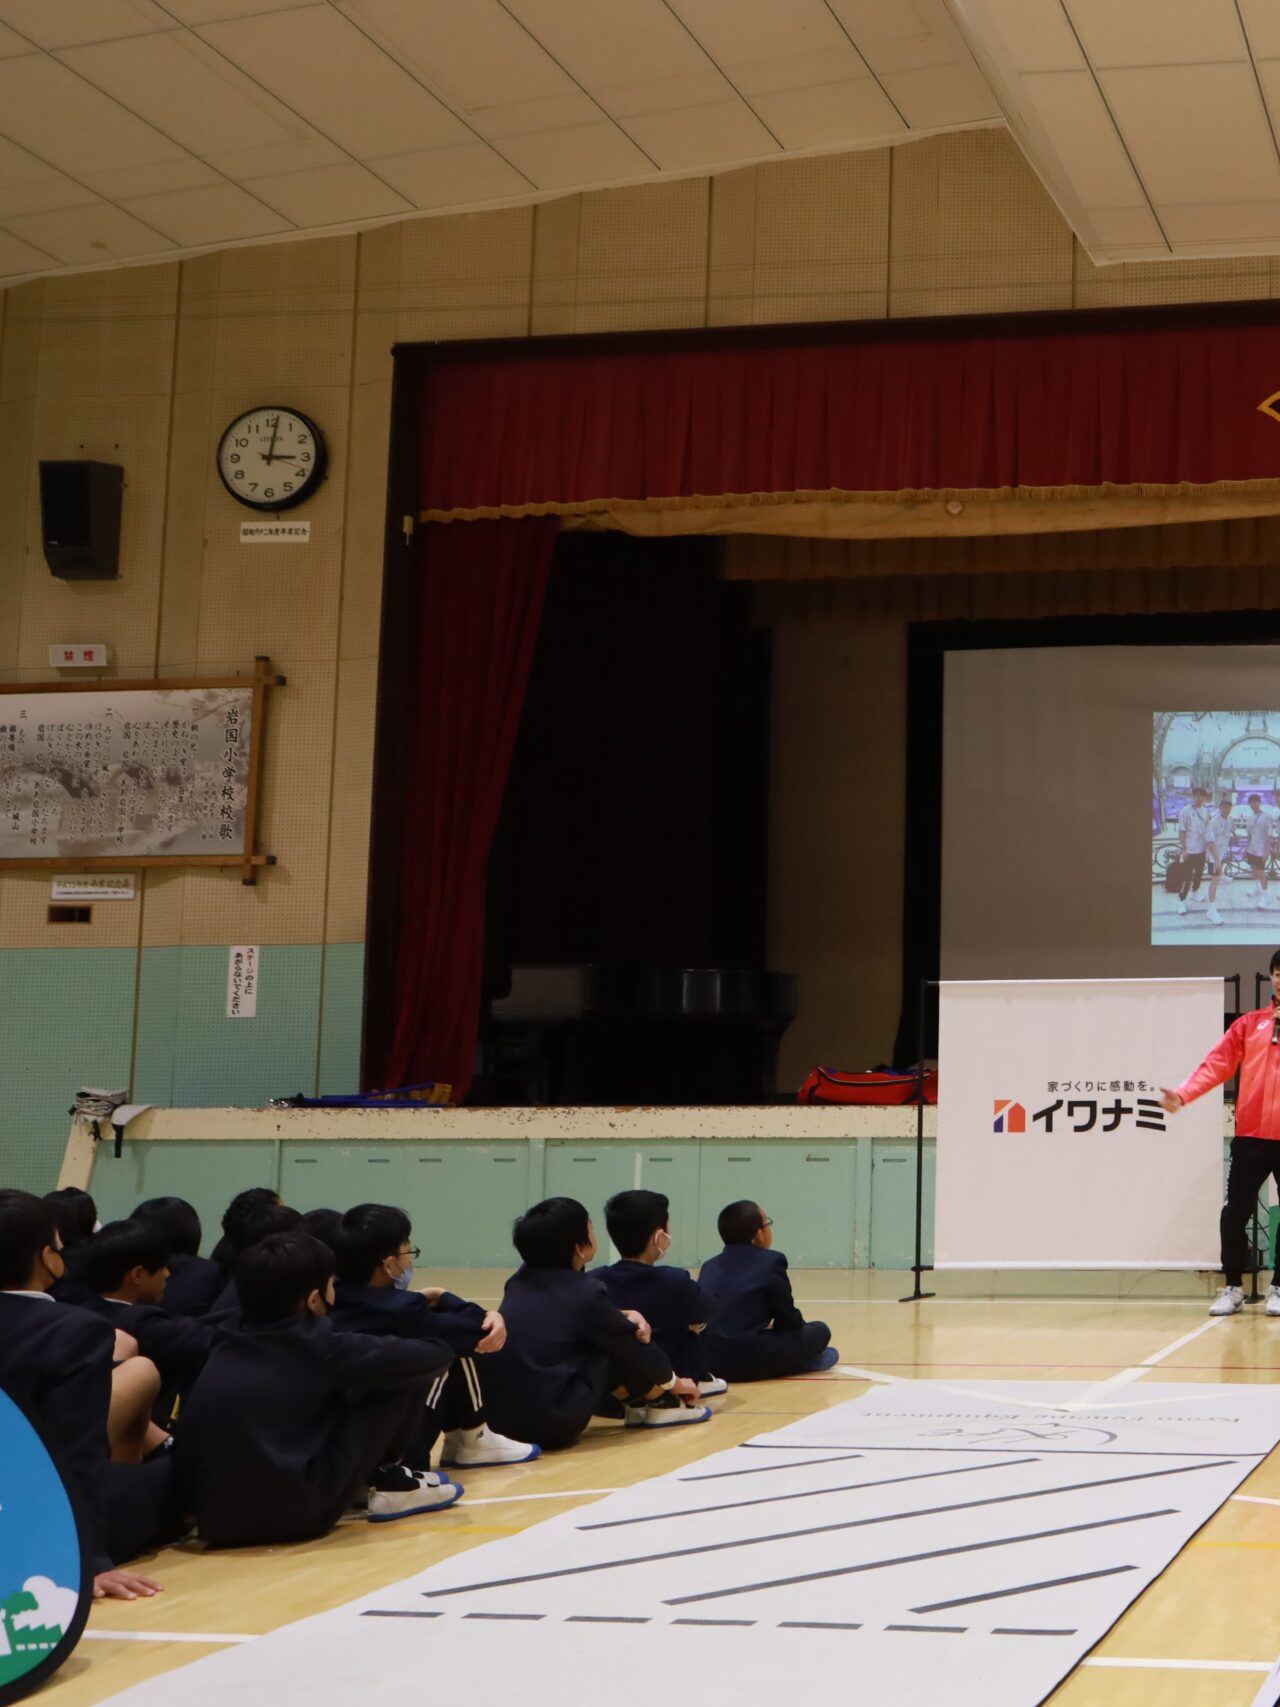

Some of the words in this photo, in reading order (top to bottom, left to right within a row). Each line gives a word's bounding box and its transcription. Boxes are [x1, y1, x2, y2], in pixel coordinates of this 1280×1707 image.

[247, 424, 259, 434] 11
[288, 422, 293, 432] 1
[235, 438, 249, 448] 10
[297, 434, 308, 444] 2
[230, 453, 241, 464] 9
[301, 452, 311, 462] 3
[234, 470, 245, 480] 8
[295, 468, 306, 478] 4
[248, 482, 259, 492] 7
[283, 482, 293, 492] 5
[264, 488, 275, 498] 6
[218, 707, 240, 841] 岩国小学校校歌
[244, 947, 255, 995] ステージの上に
[231, 952, 243, 1015] あがらないでください
[1047, 1080, 1156, 1093] 家づくりに感動を。
[1032, 1098, 1167, 1133] イワナミ
